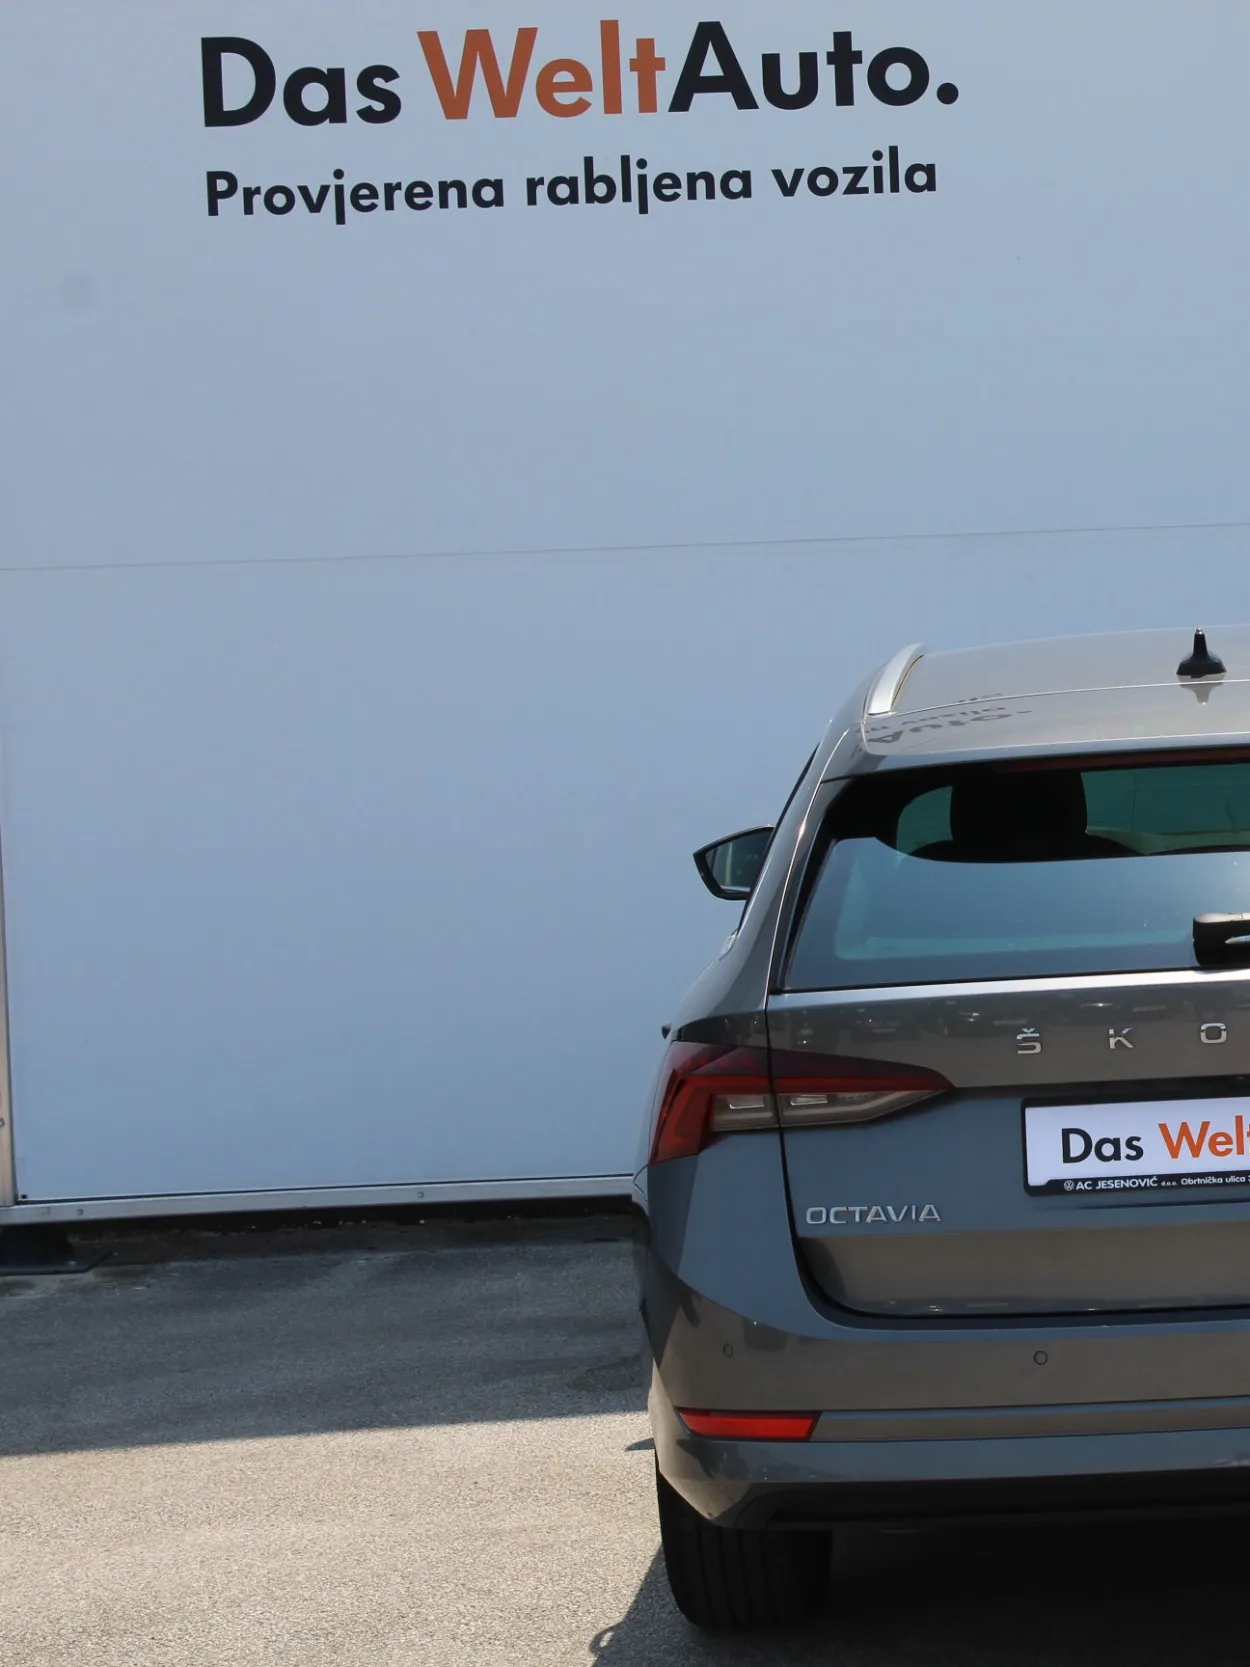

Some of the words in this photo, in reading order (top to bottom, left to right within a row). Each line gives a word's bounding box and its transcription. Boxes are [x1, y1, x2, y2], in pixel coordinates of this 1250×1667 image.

[200, 35, 402, 127] Das
[416, 19, 960, 121] WeltAuto.
[206, 168, 504, 226] Provjerena
[526, 155, 752, 215] rabljena
[771, 145, 938, 198] vozila
[1061, 1124, 1145, 1164] Das
[1076, 1181, 1093, 1190] AC
[1096, 1176, 1159, 1190] JESENOVIĆ
[1181, 1175, 1223, 1185] Obrtnička
[1225, 1174, 1246, 1183] ulica
[805, 1204, 941, 1226] OCTAVIA
